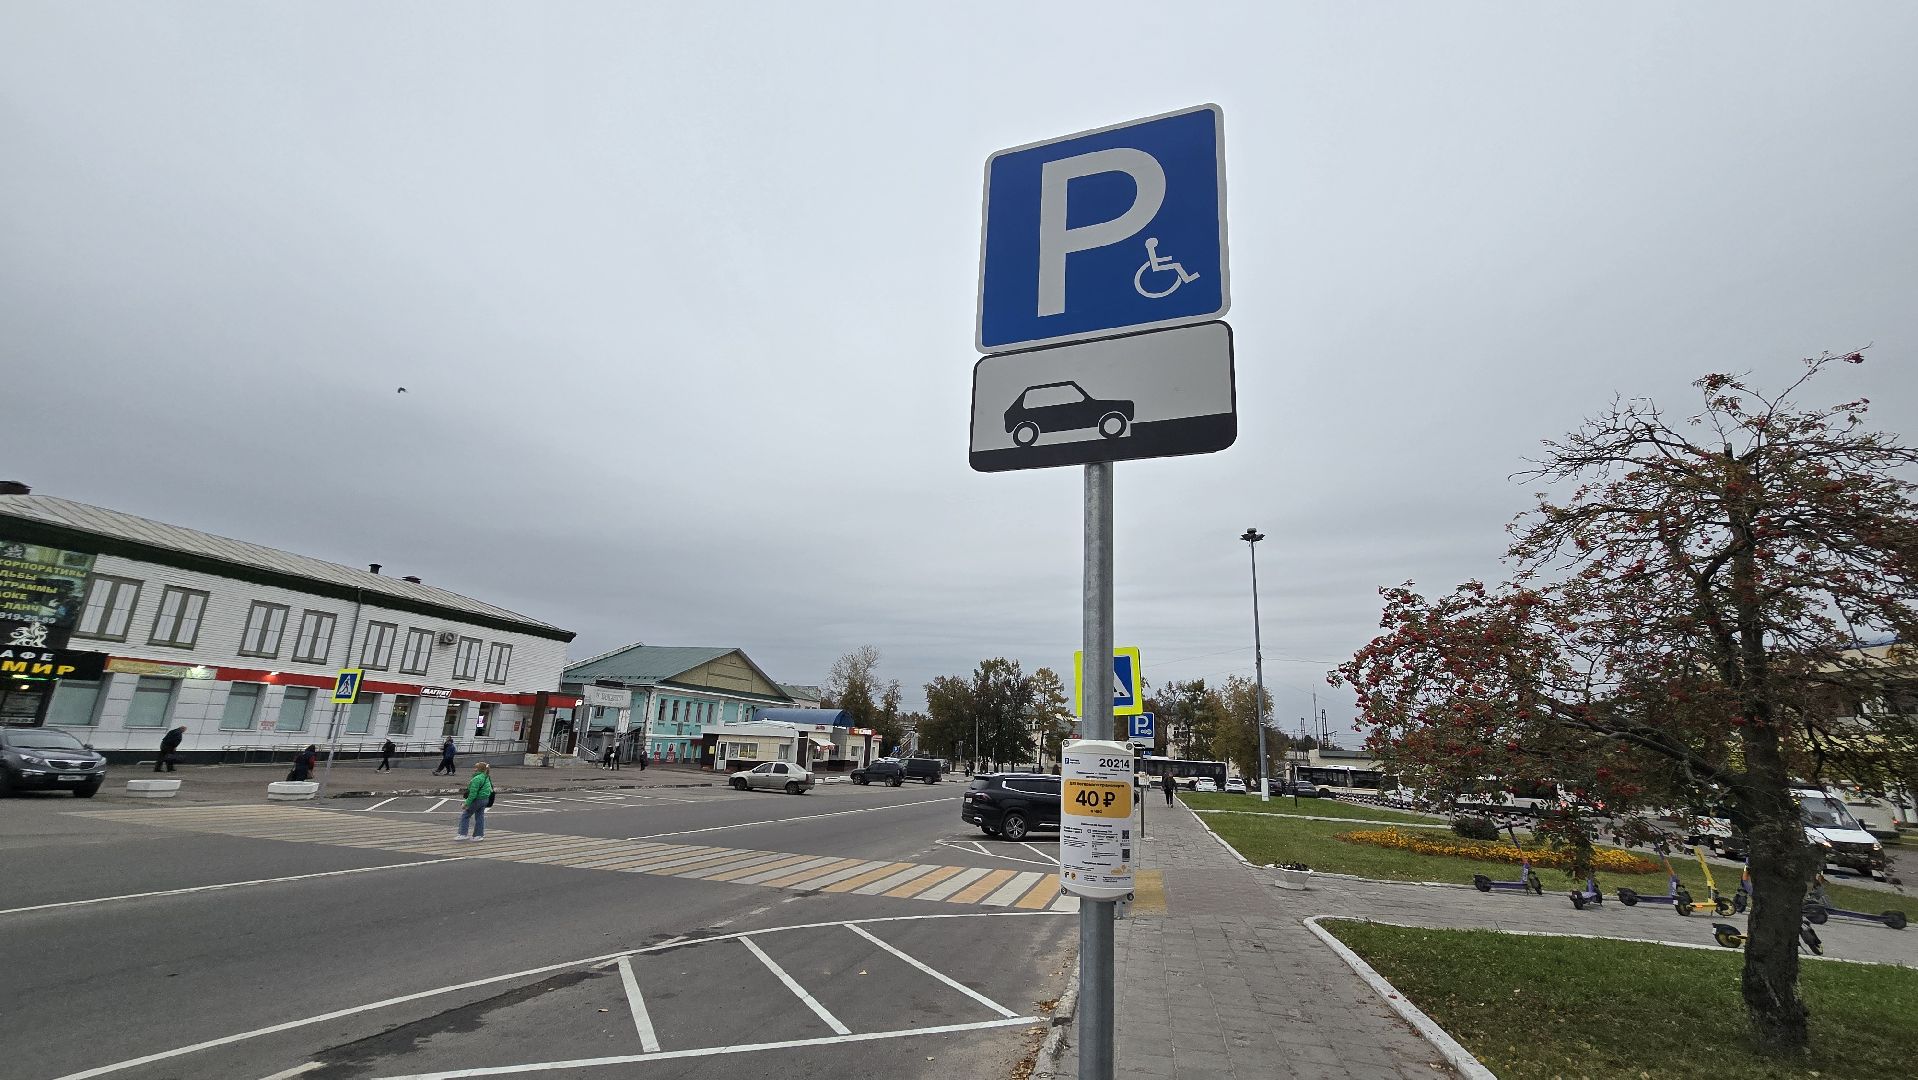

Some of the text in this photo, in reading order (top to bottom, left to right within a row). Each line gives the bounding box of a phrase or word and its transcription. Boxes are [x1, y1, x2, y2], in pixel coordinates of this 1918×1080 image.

[1038, 147, 1167, 318] P
[0, 591, 28, 600] ОКЕ
[1, 660, 76, 675] МИР
[1135, 715, 1149, 735] P
[1099, 758, 1130, 769] 20214
[1075, 789, 1116, 808] 40 ₽
